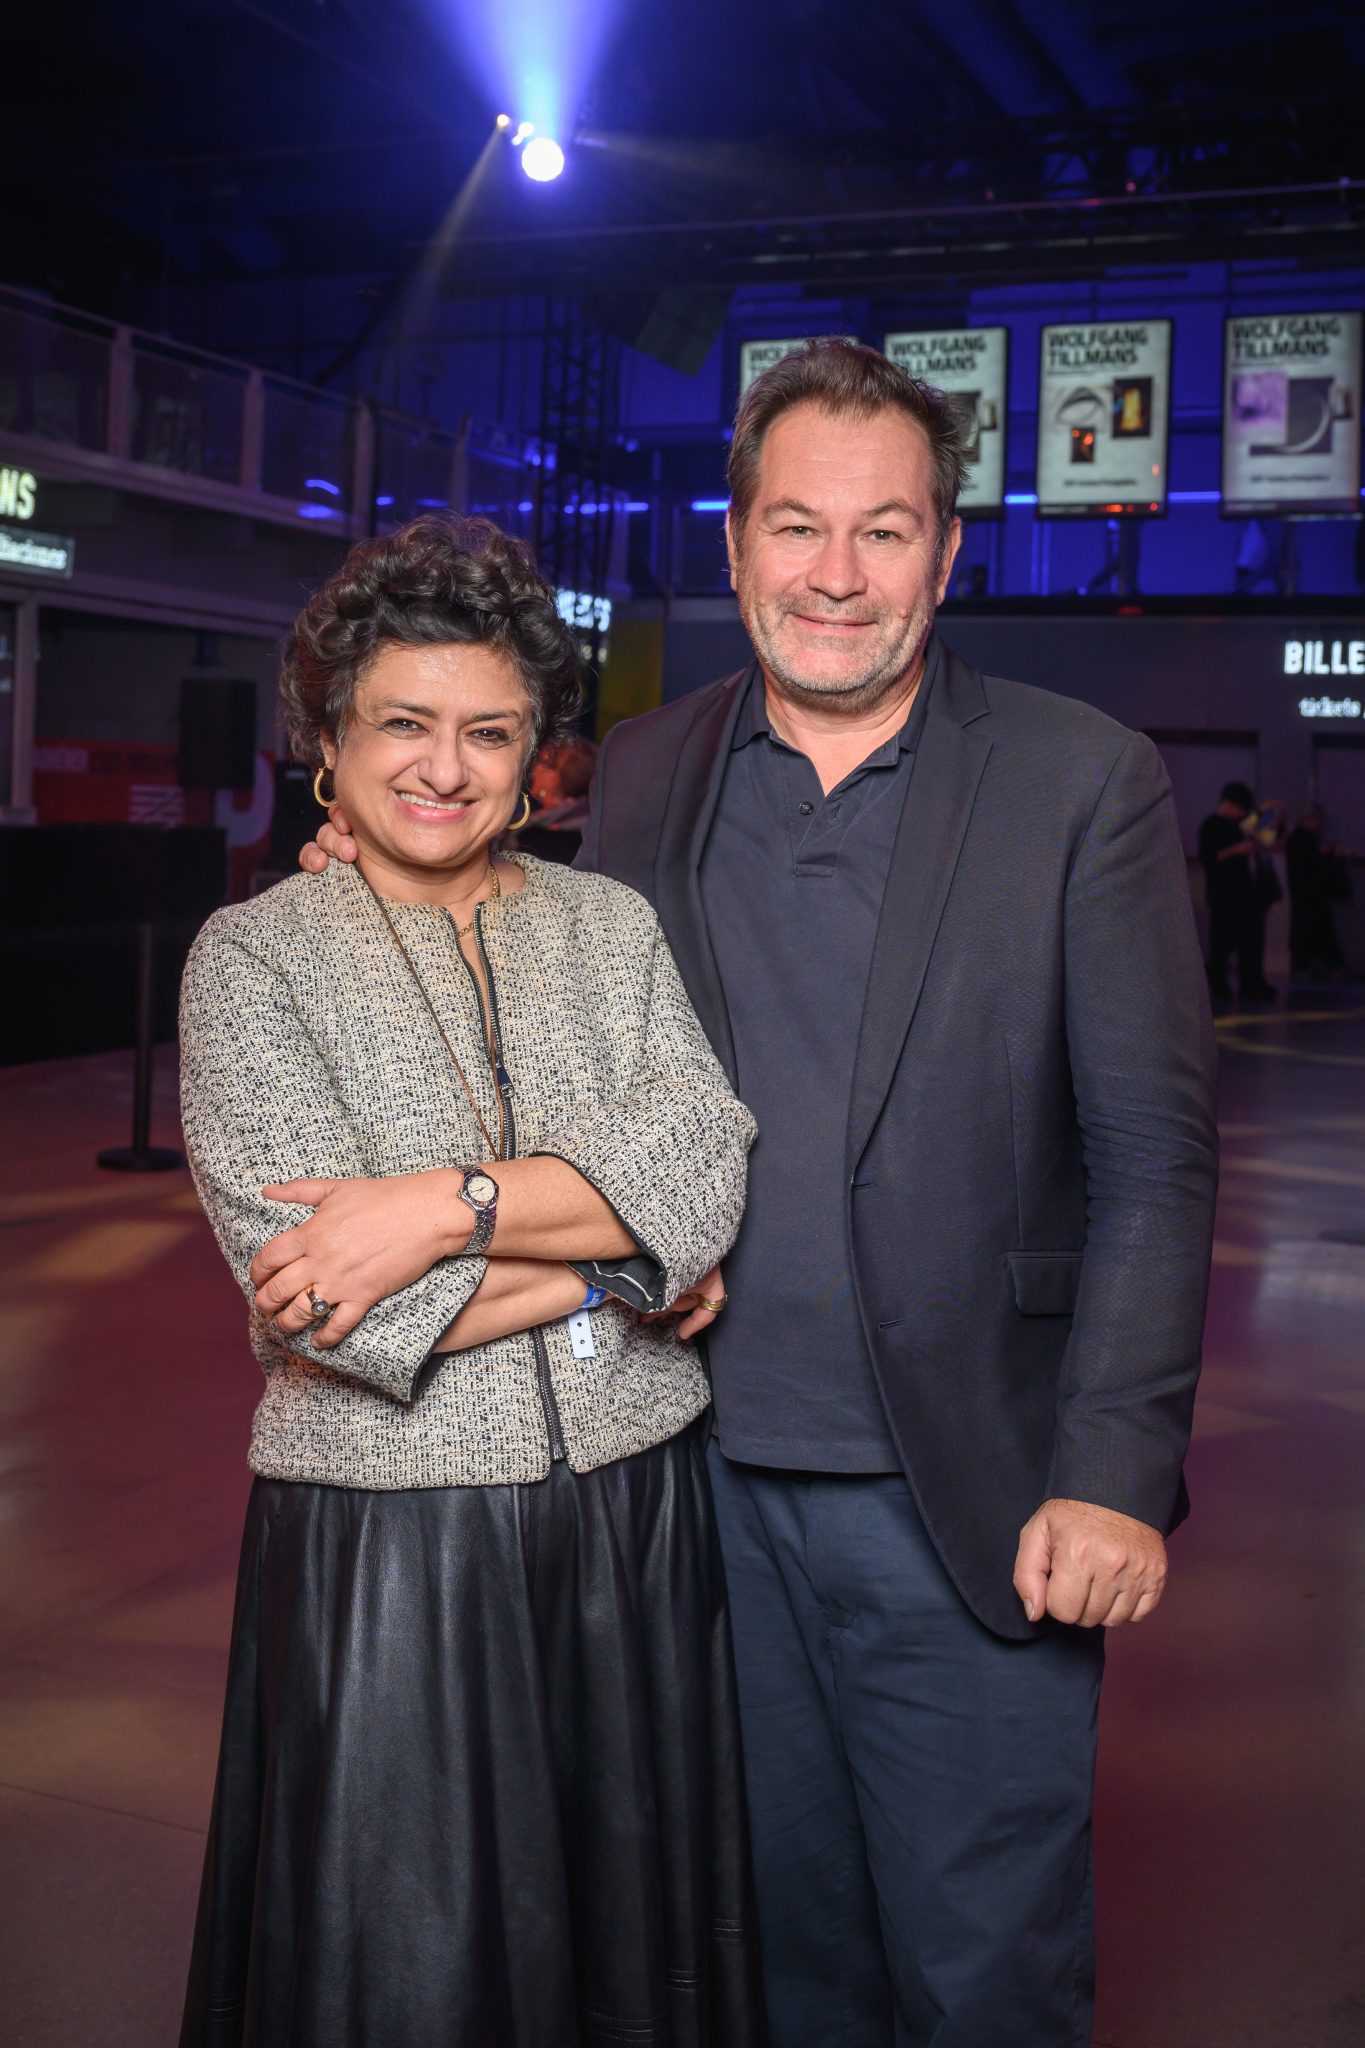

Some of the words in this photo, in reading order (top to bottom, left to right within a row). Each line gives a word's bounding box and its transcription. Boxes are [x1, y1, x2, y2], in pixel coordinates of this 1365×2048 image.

[1047, 327, 1148, 348] WOLFGANG
[1233, 318, 1341, 339] WOLFGANG
[891, 334, 987, 356] WOLFGANG
[1233, 338, 1330, 360] TILLMANS
[1047, 345, 1139, 368] TILLMANS
